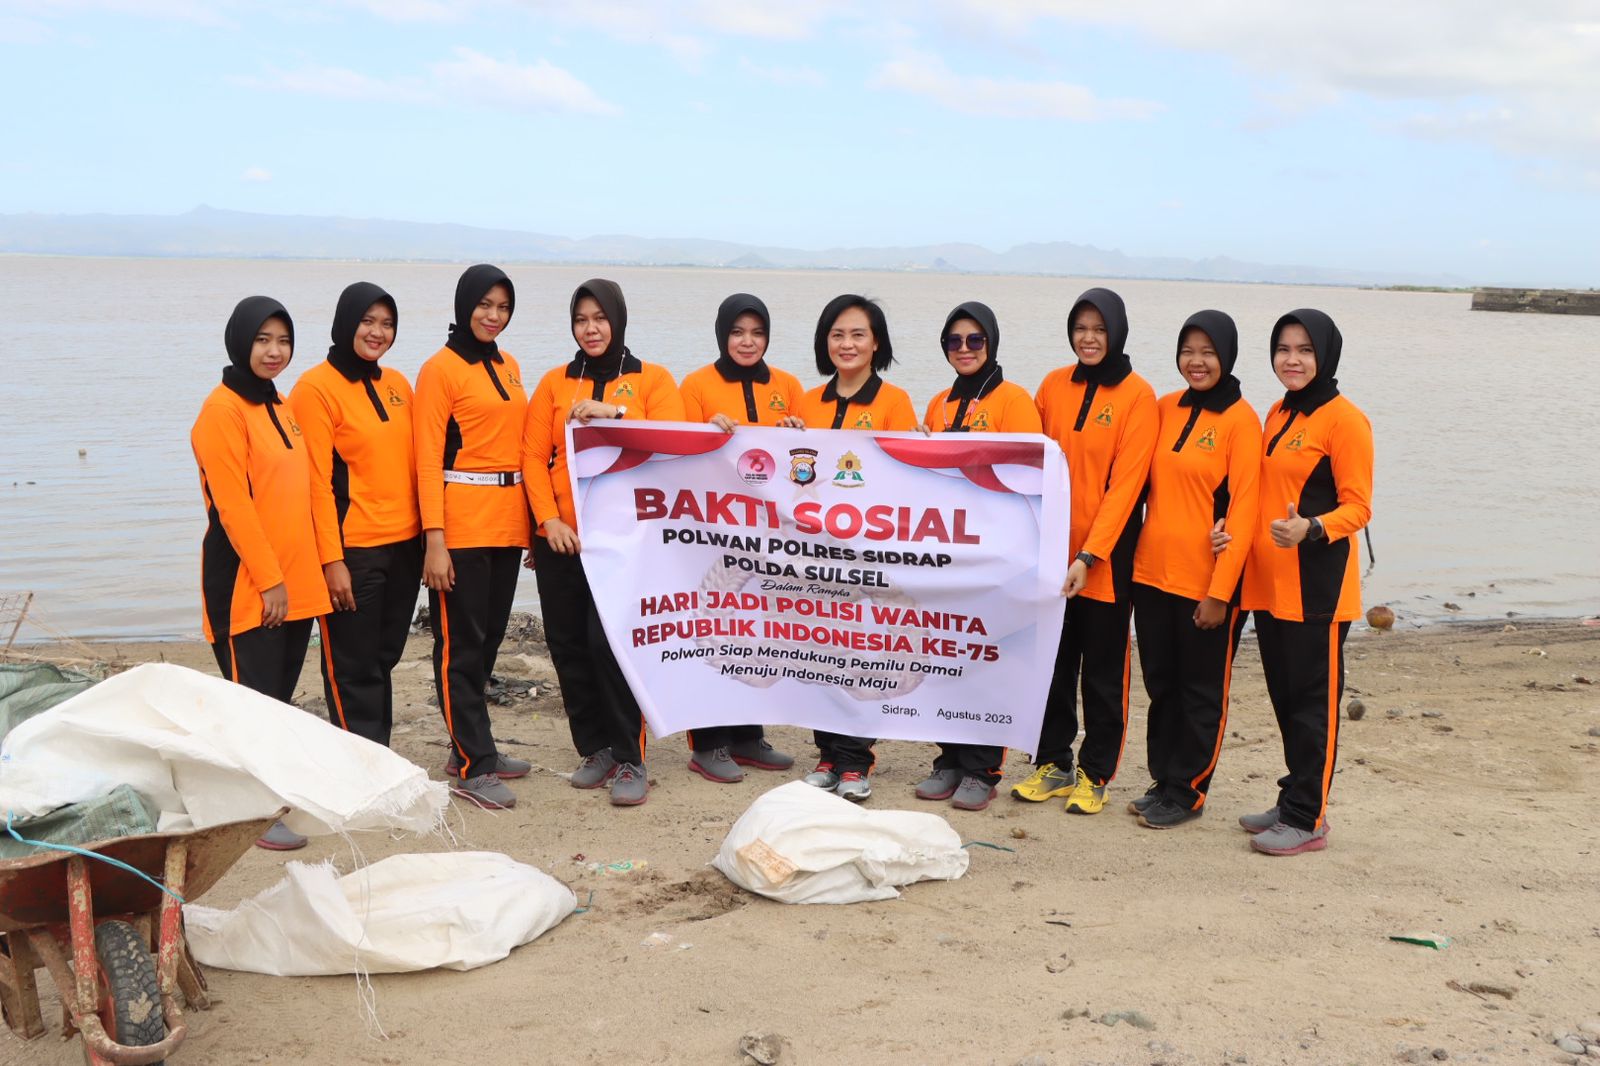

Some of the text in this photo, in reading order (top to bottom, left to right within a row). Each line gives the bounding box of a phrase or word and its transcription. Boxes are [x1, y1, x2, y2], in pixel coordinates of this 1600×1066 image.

[634, 488, 980, 544] BAKTI SOSIAL
[662, 528, 952, 568] POLWAN POLRES SIDRAP
[723, 554, 889, 588] POLDA SULSEL
[760, 580, 851, 598] Dalam Rangka
[640, 591, 988, 636] HARI JADI POLISI WANITA
[632, 618, 999, 663] REPUBLIK INDONESIA KE-75
[660, 644, 963, 678] Polwan Siap Mendukung Pemilu Damai
[720, 663, 898, 692] Menuju Indonesia Maju
[936, 708, 981, 724] Agustus
[984, 711, 1013, 725] 2023
